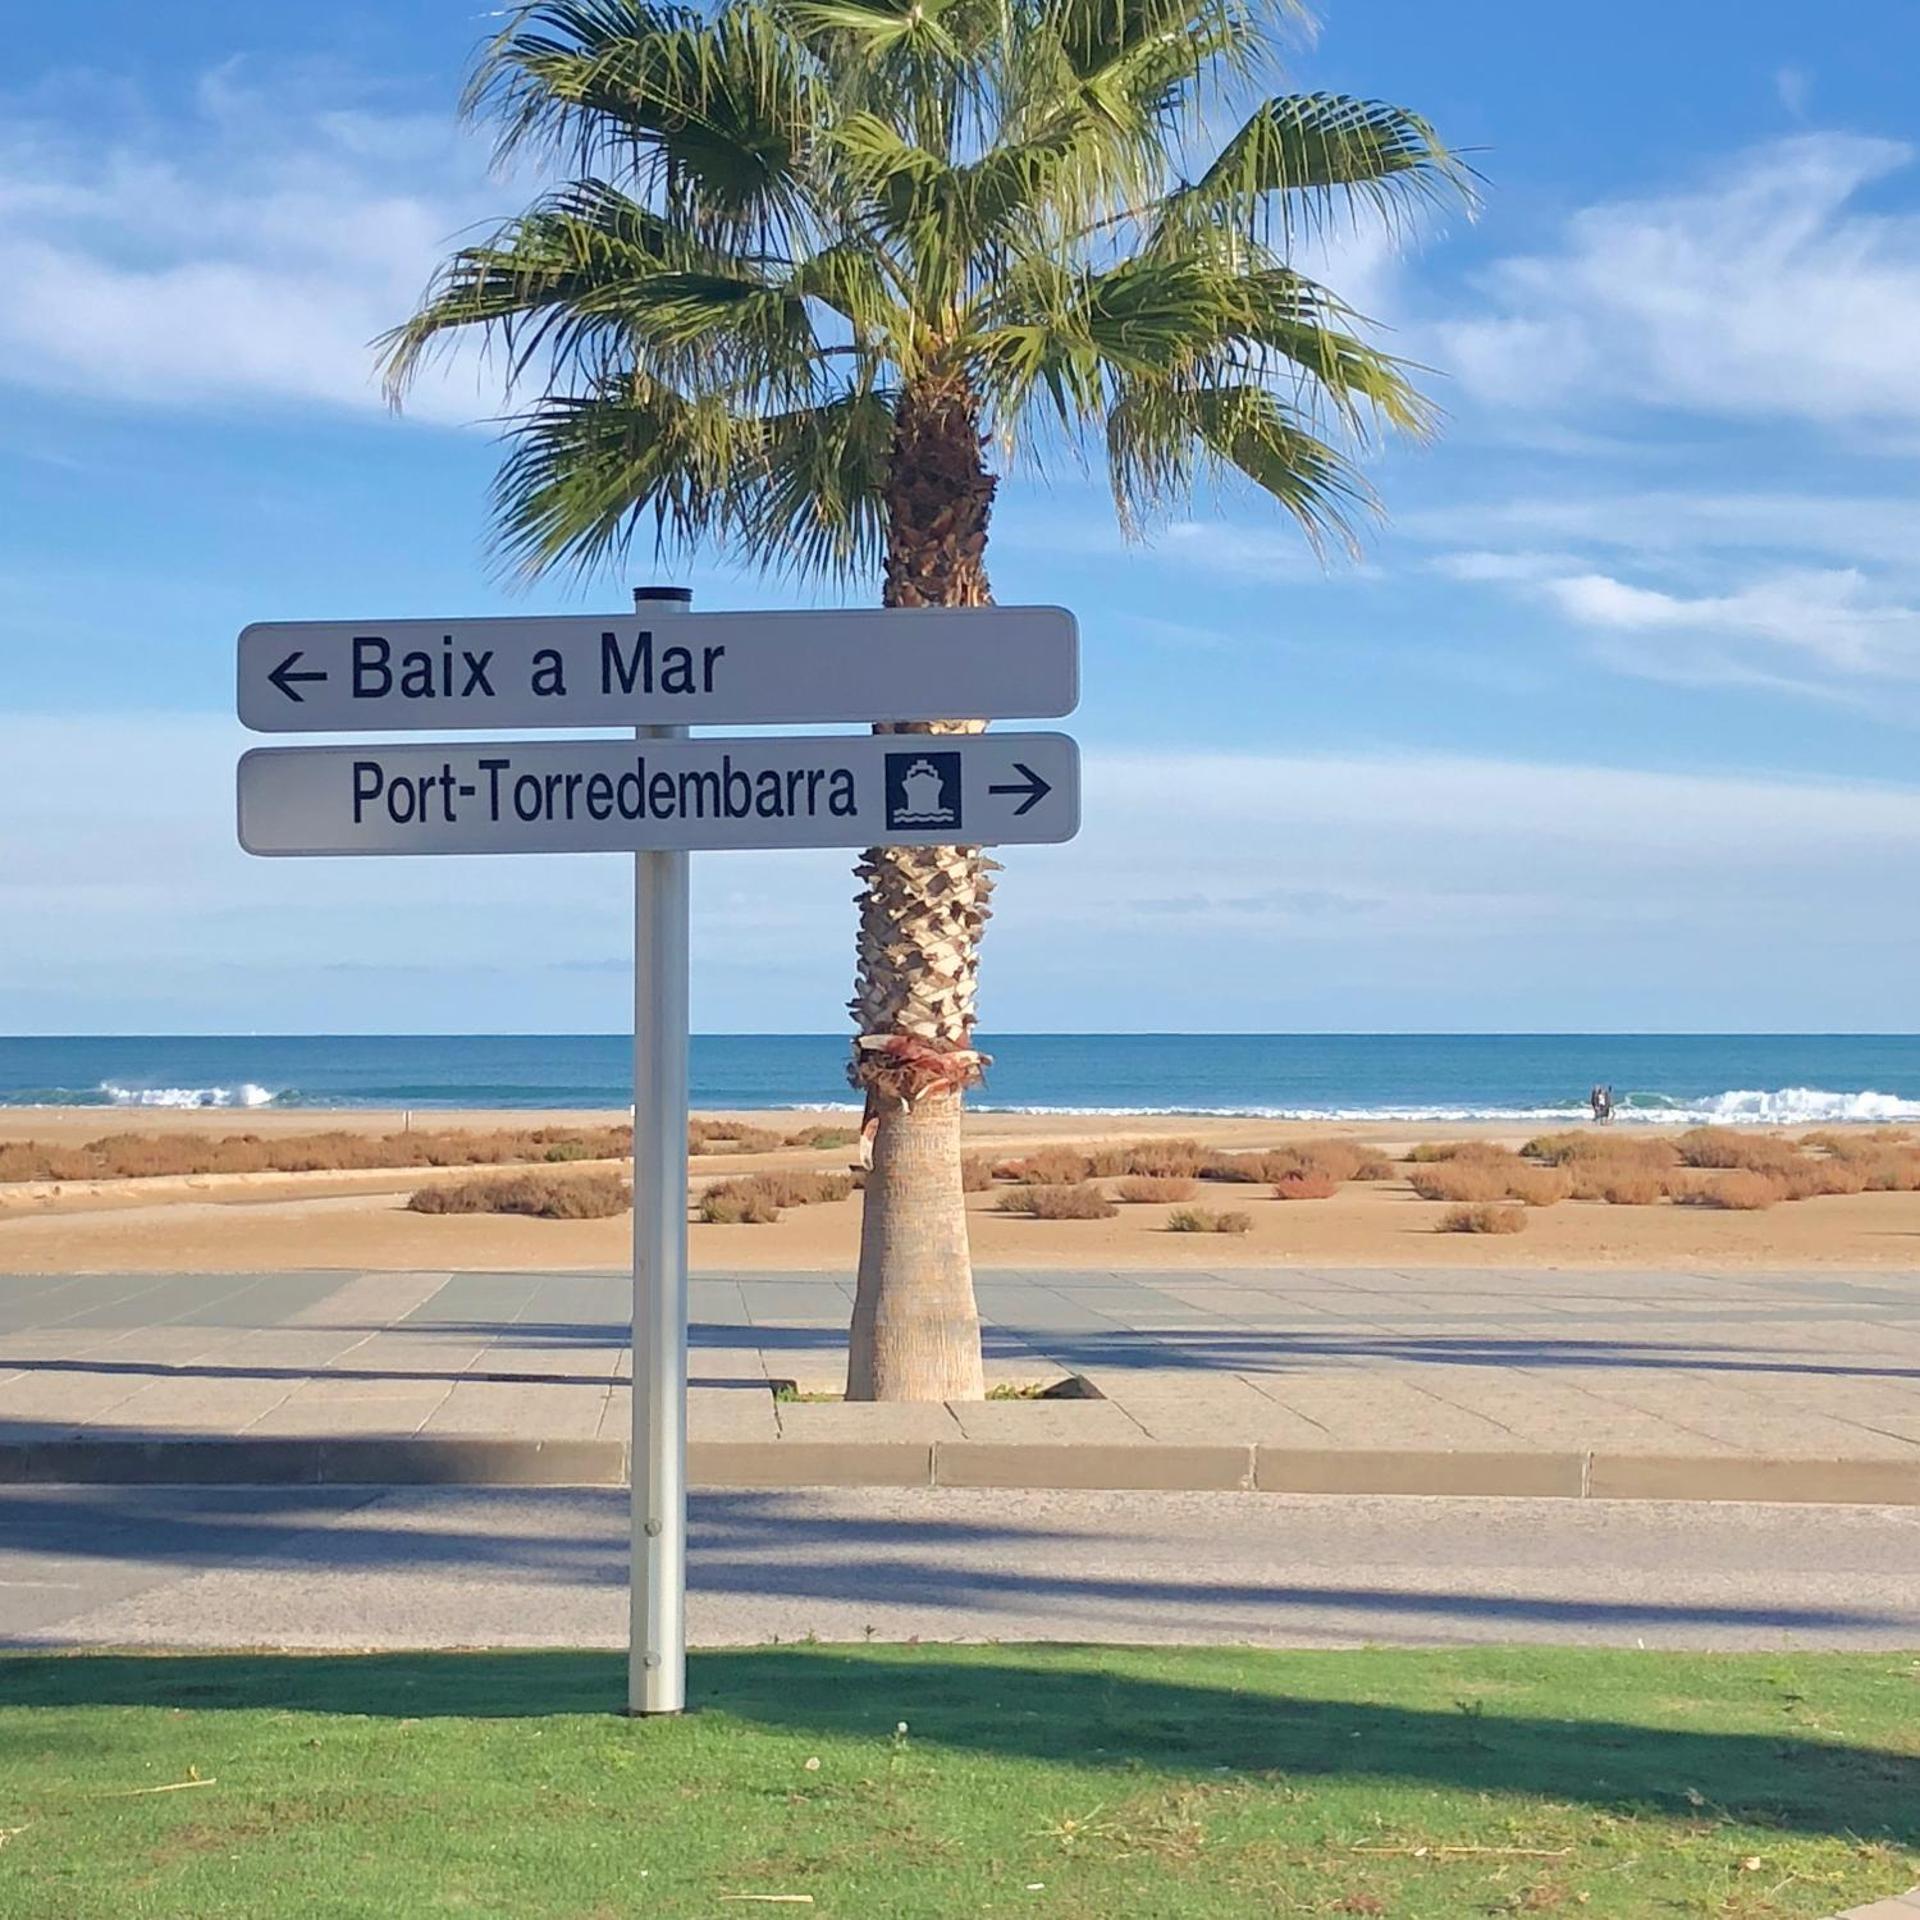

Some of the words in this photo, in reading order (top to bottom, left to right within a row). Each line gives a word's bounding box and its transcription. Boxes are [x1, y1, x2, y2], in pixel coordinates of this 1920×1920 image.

[353, 636, 496, 698] Baix
[531, 648, 567, 697] a
[601, 631, 726, 695] Mar
[353, 755, 858, 825] Port-Torredembarra
